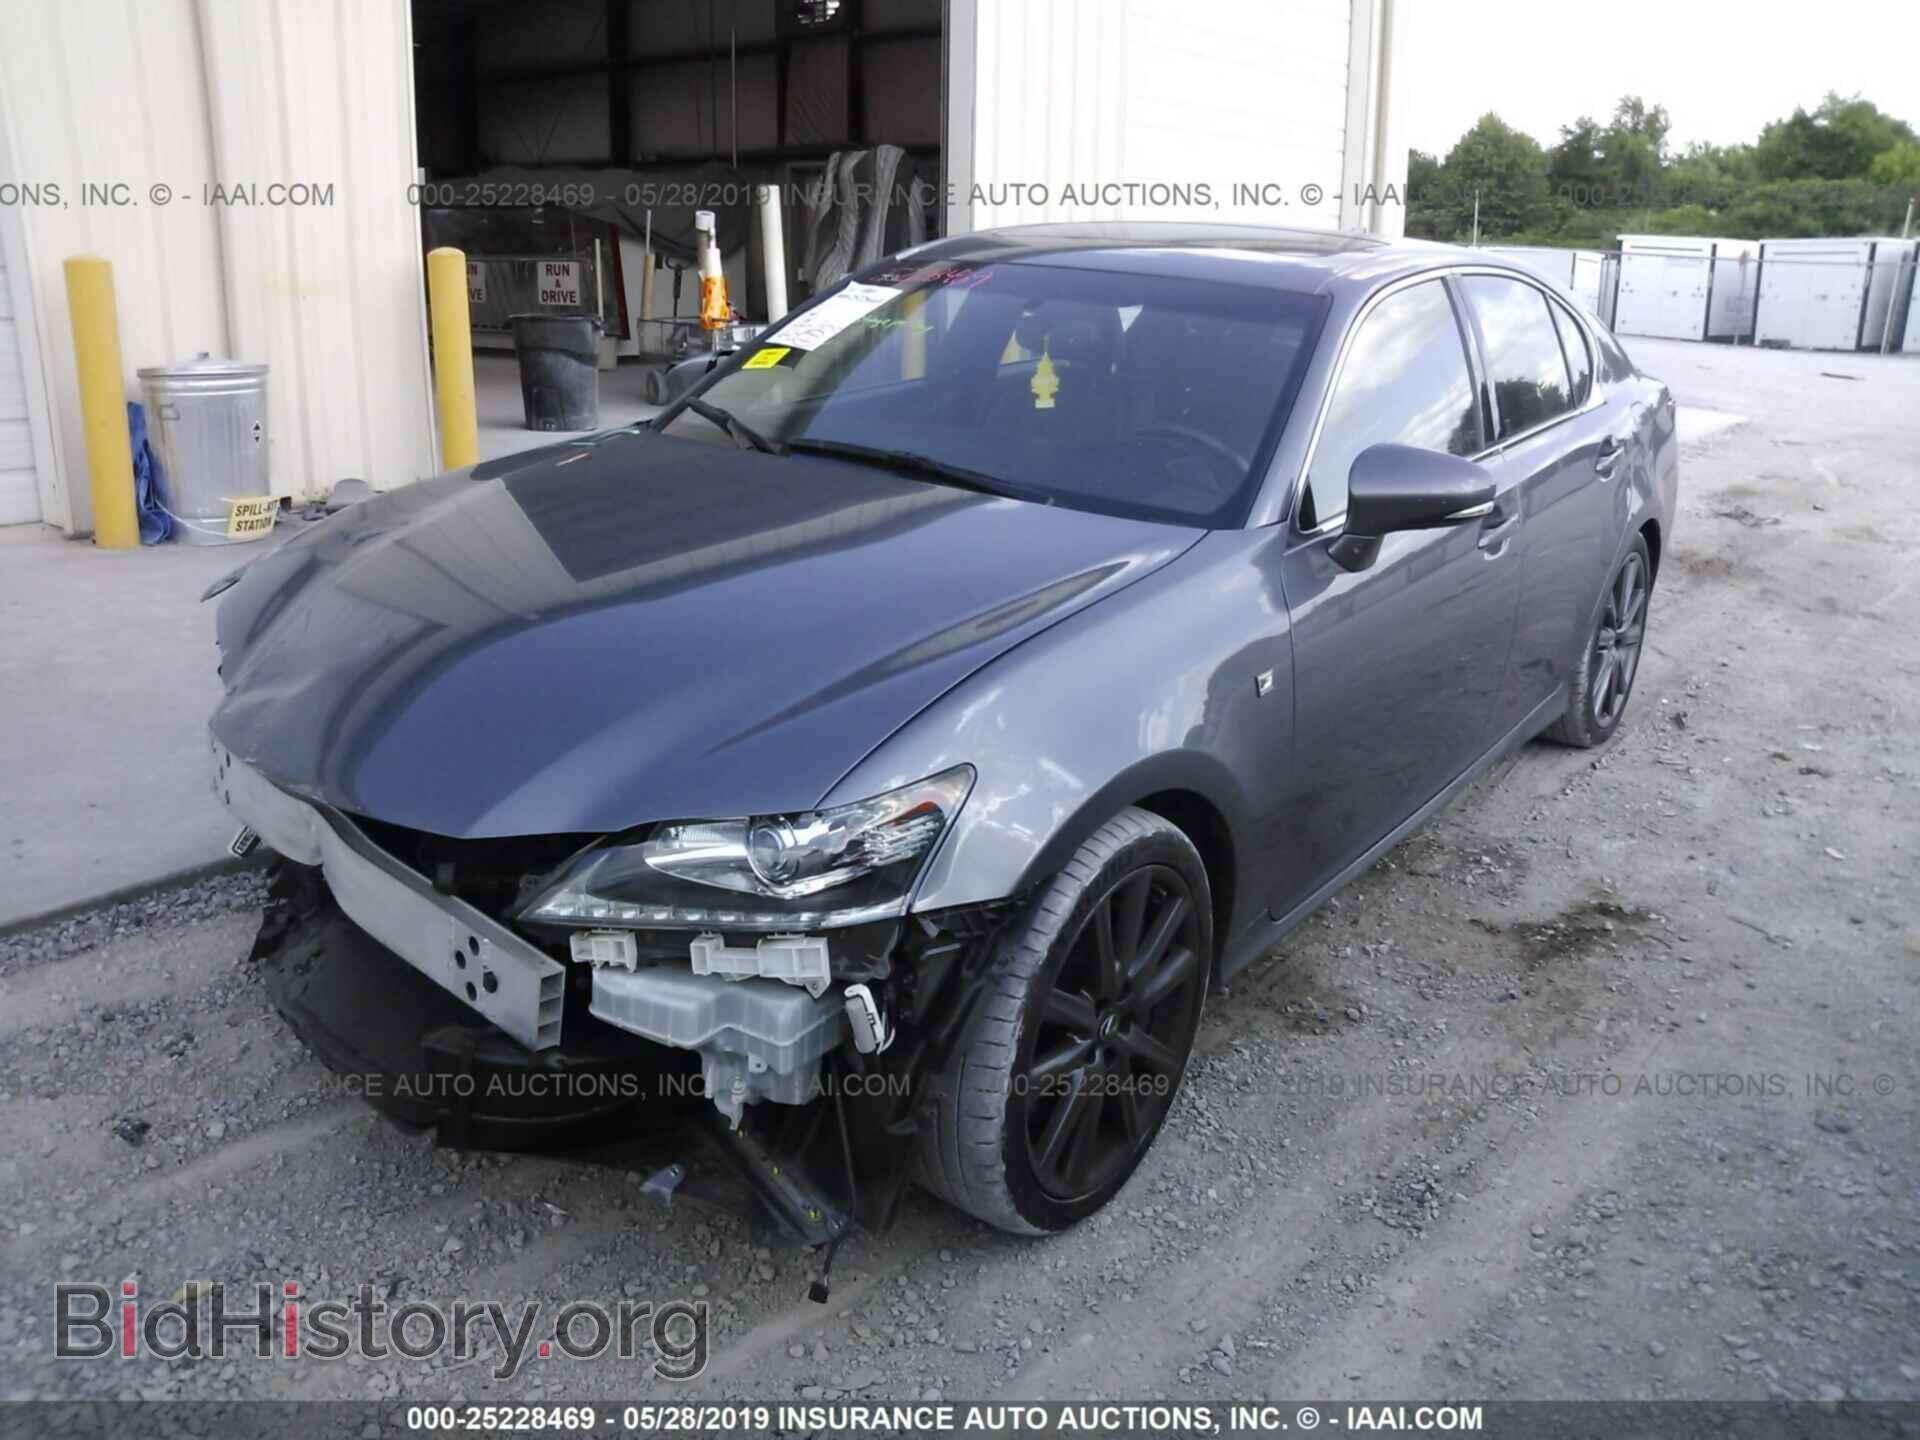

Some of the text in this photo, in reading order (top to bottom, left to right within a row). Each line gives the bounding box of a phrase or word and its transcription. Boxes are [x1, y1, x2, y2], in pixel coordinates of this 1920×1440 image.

[545, 263, 570, 276] RUN
[541, 289, 577, 303] DRIVE
[234, 516, 271, 532] STATION
